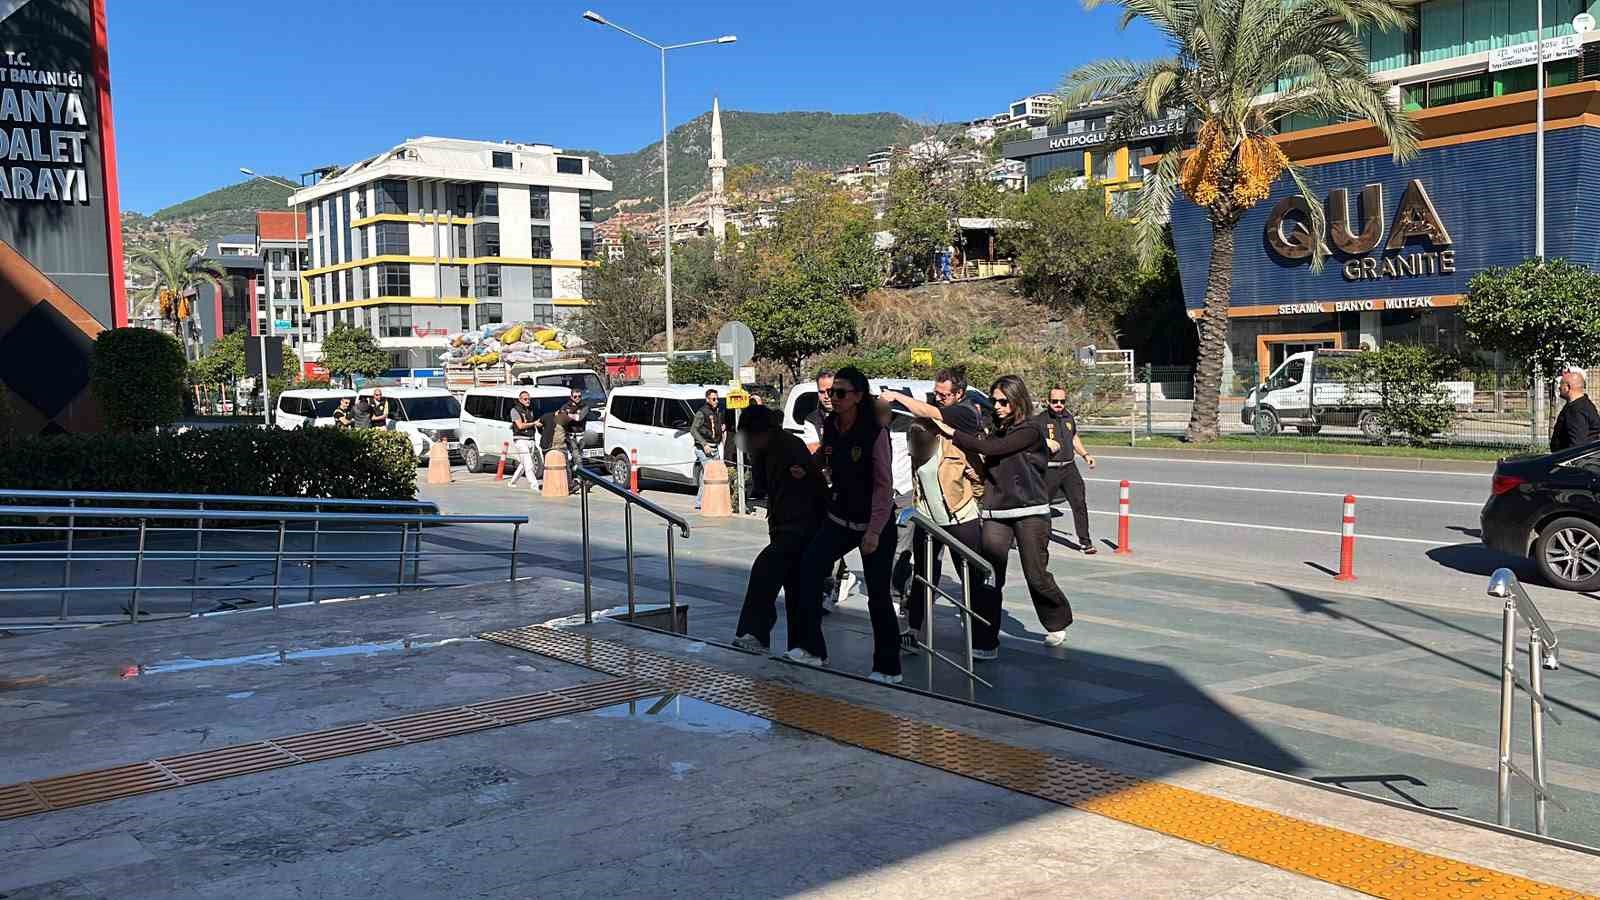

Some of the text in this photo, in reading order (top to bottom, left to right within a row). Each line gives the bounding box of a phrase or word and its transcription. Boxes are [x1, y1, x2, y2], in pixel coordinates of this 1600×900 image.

[6, 51, 31, 66] T.C.
[11, 69, 83, 87] BAKANLIĞI
[0, 88, 88, 126] ANYA
[1266, 178, 1453, 260] QUA
[1343, 249, 1456, 280] GRANITE
[1335, 299, 1373, 312] BANYO
[1385, 296, 1432, 309] MUTFAK
